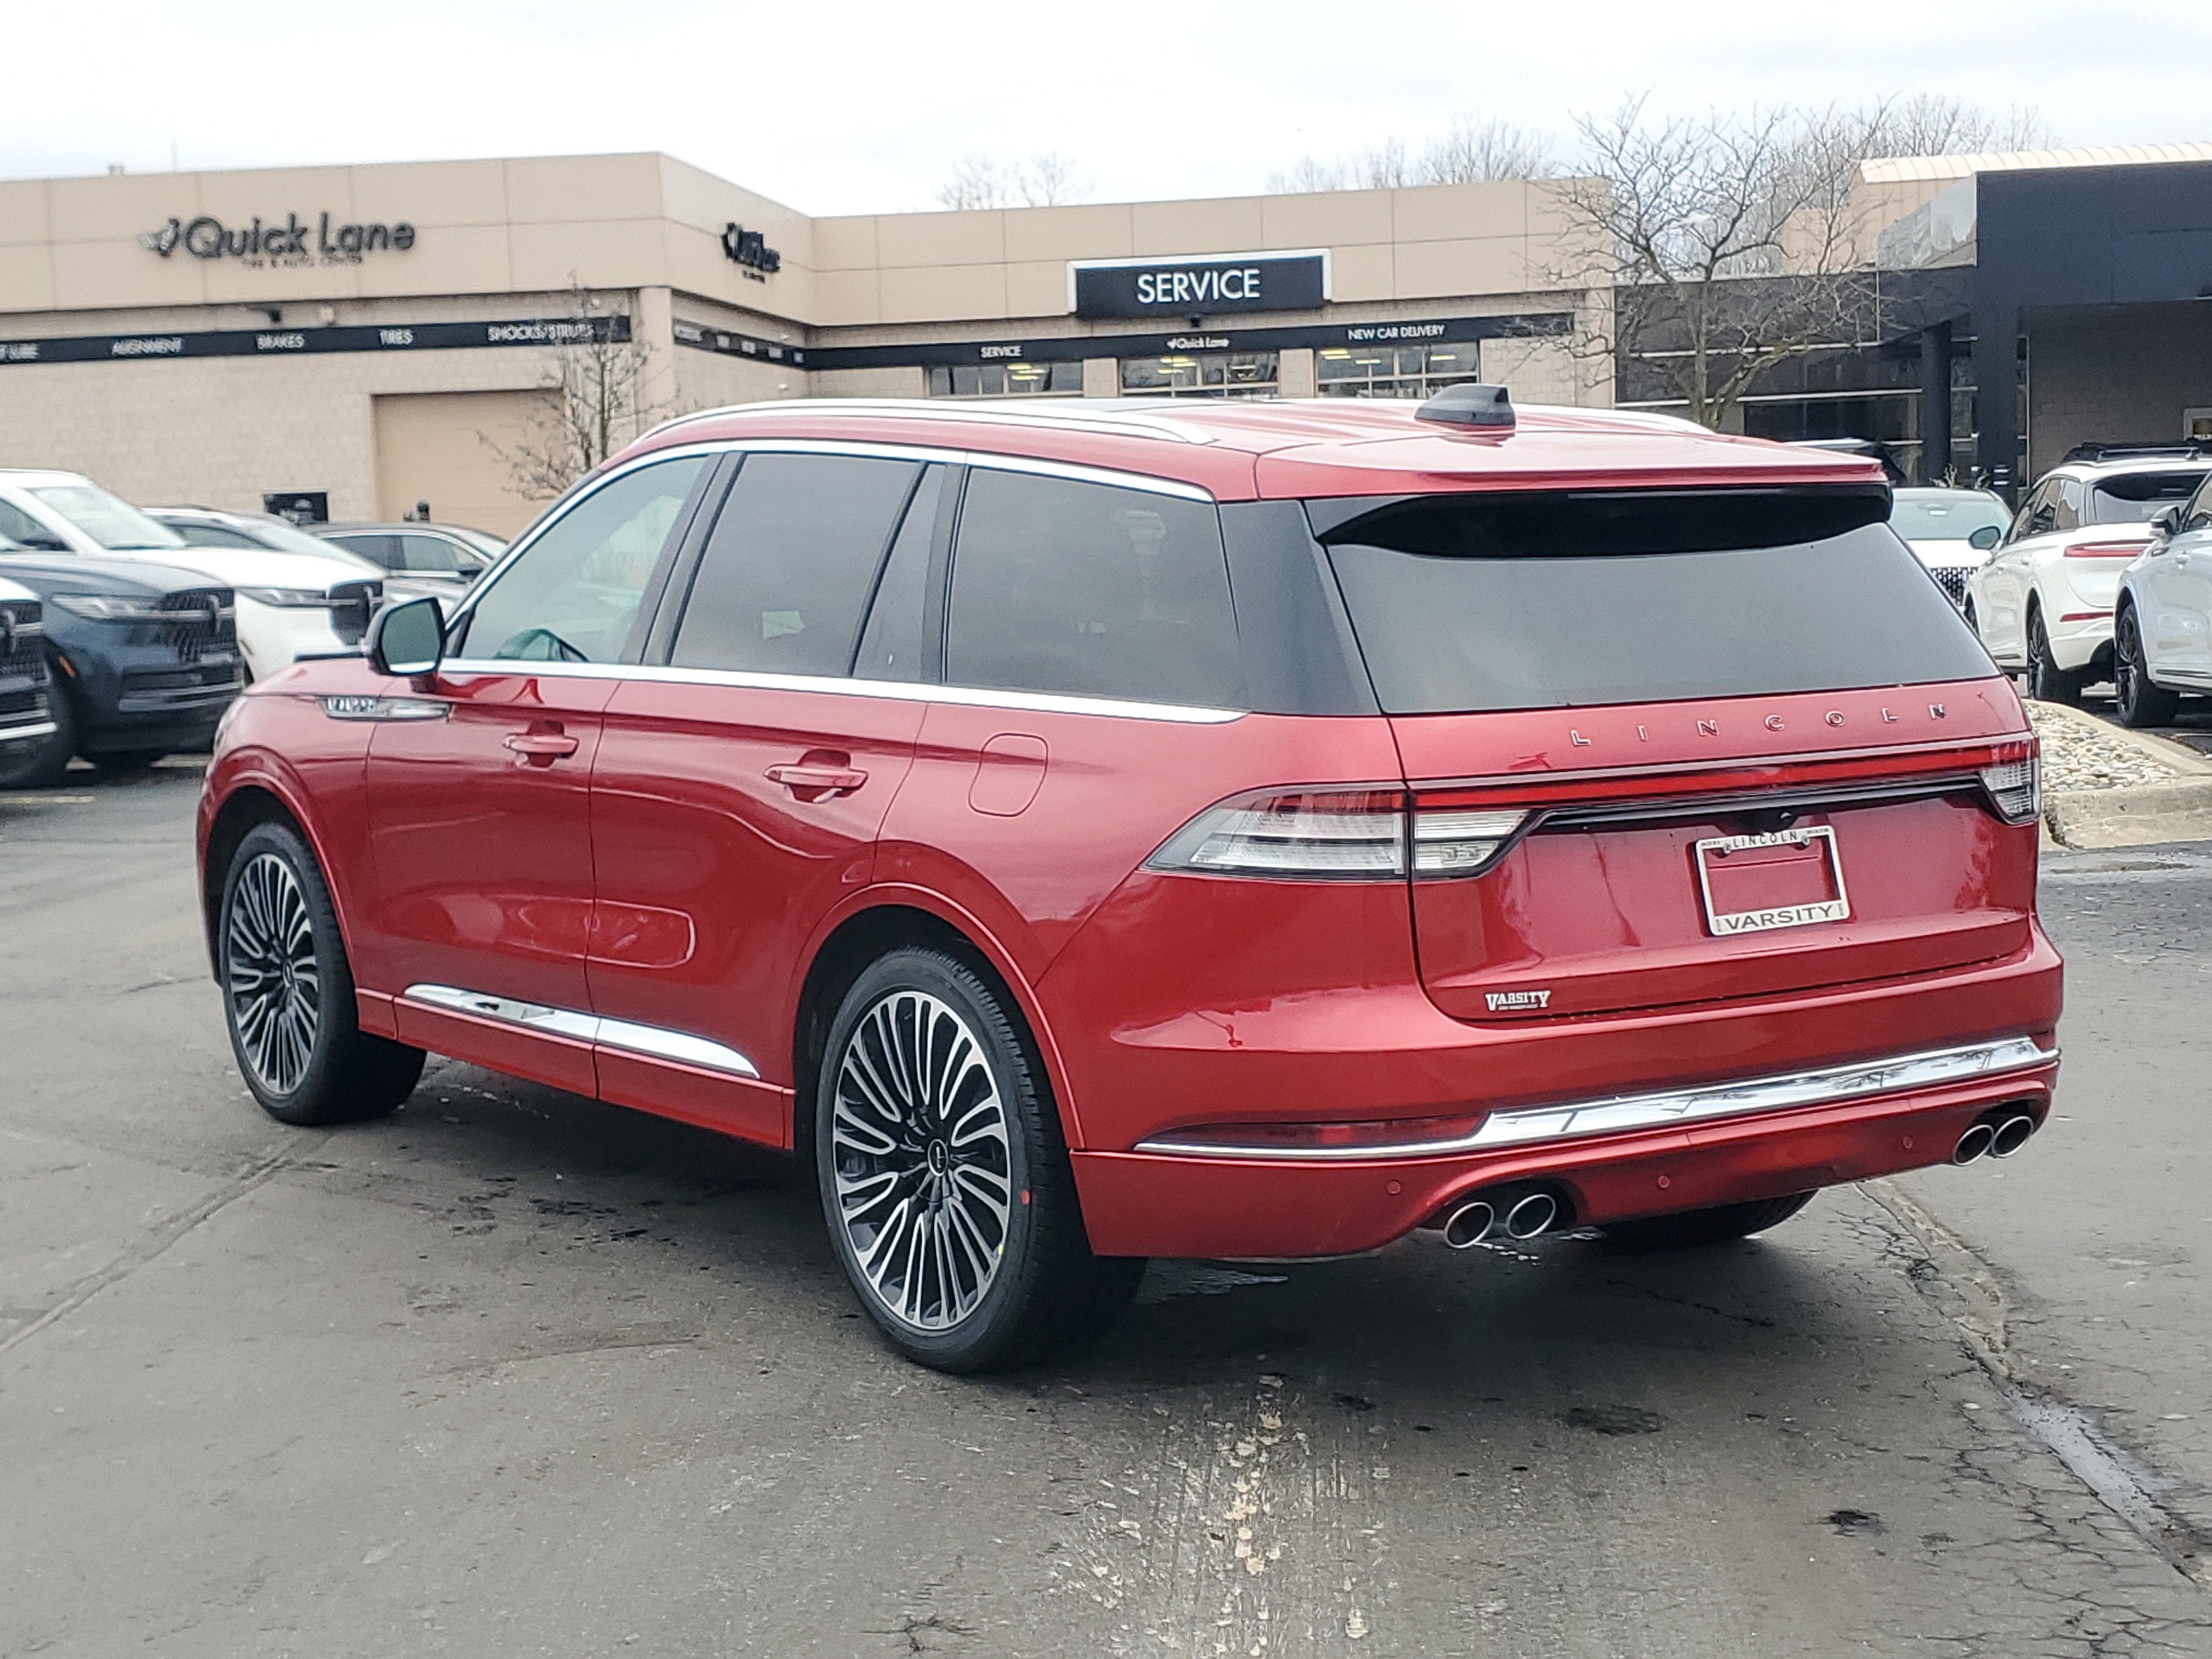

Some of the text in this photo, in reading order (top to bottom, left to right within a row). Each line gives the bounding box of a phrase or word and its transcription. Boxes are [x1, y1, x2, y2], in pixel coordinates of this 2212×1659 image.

[185, 212, 415, 258] Quick Lane
[1137, 268, 1260, 303] SERVICE
[256, 332, 305, 349] BRAKES
[1347, 324, 1445, 340] NEW CAR DELIVERY
[1176, 336, 1204, 349] Quick
[980, 346, 1022, 359] SERVICE
[1570, 704, 1948, 747] LINCOLN
[1732, 831, 1798, 848] LINCOLN
[1724, 905, 1833, 930] VARSITY
[1485, 990, 1551, 1011] VARSITY
